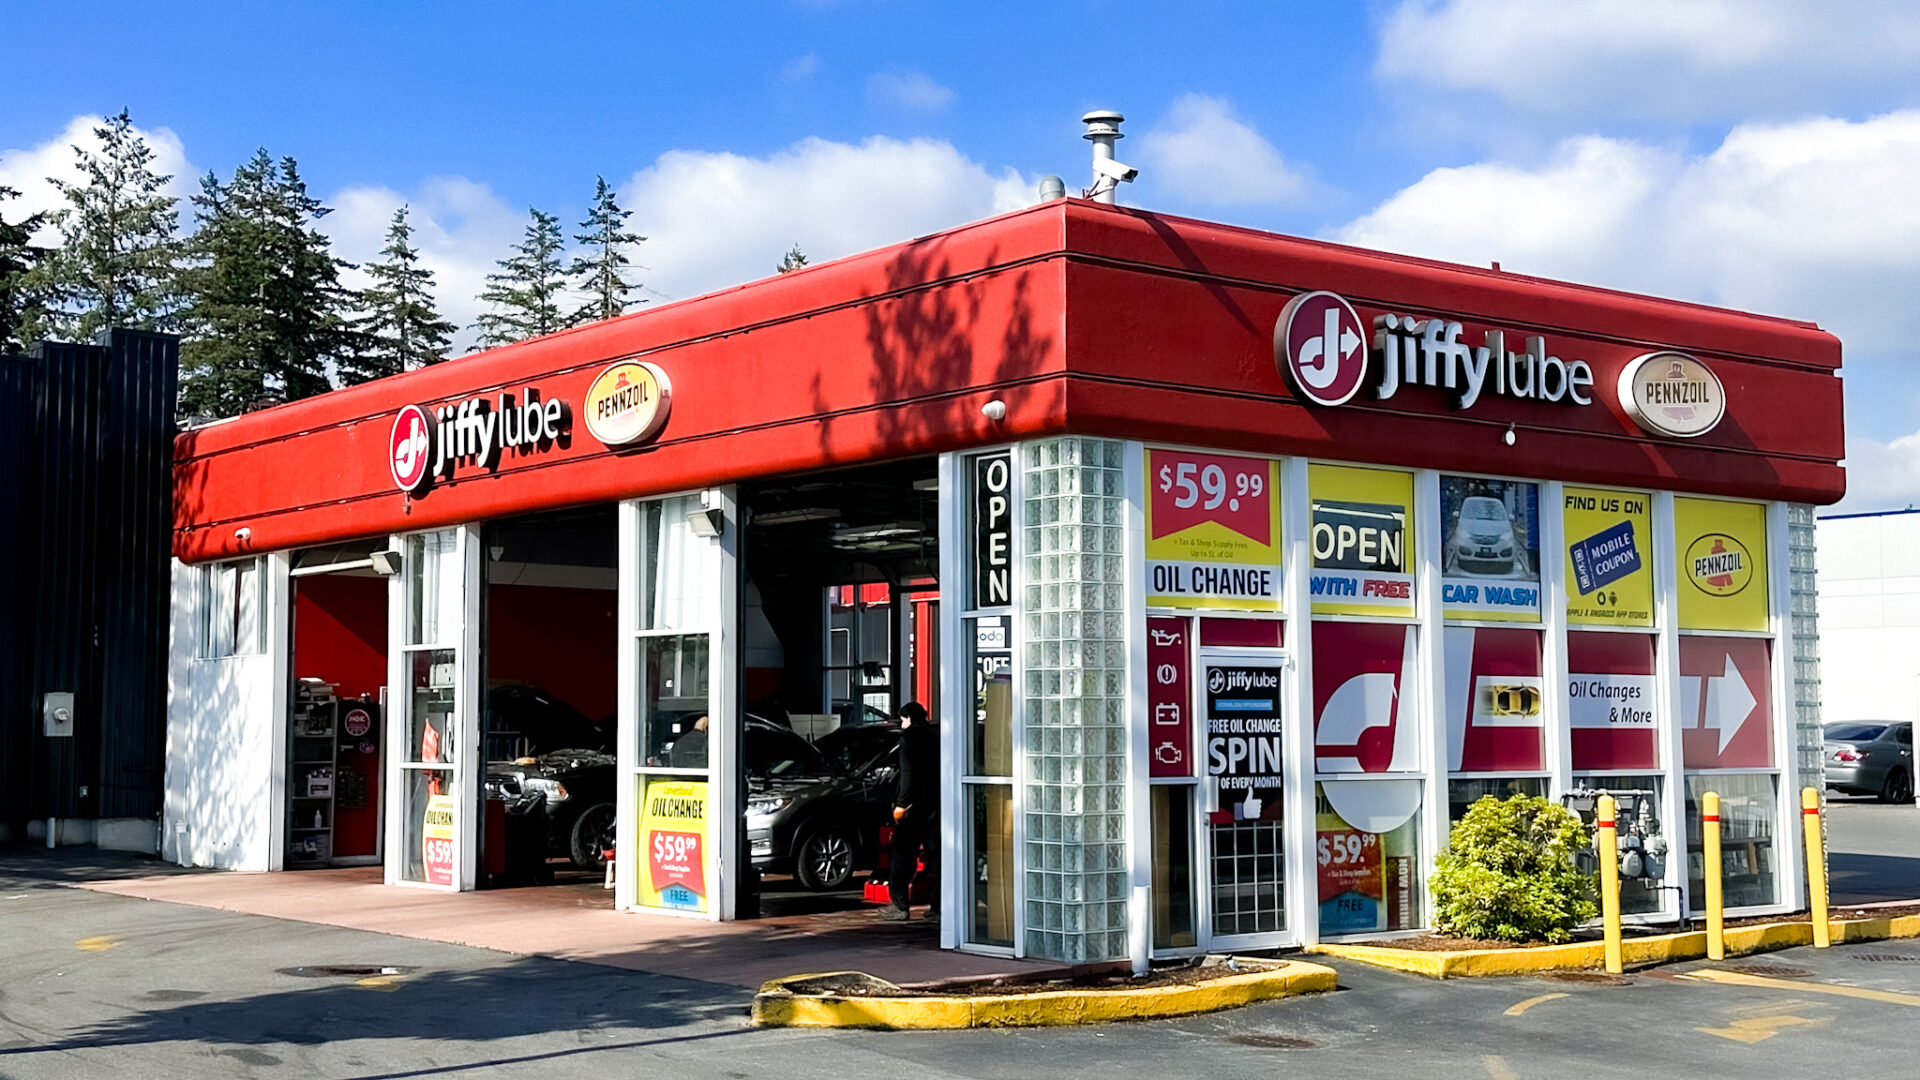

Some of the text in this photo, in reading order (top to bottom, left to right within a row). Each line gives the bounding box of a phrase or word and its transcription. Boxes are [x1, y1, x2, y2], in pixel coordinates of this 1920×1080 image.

[1373, 313, 1594, 410] jiffy lube
[597, 380, 649, 420] PENNZOIL
[1645, 379, 1710, 405] PENNZOIL
[433, 387, 562, 477] jiffy lube
[1159, 462, 1264, 512] $59.99
[1565, 496, 1643, 514] FIND US ON
[986, 459, 1009, 603] OPEN
[1312, 521, 1402, 569] OPEN
[1591, 532, 1631, 560] MOBILE
[1595, 548, 1635, 576] COUPON
[1694, 559, 1743, 578] PENNZOIL
[1153, 565, 1271, 597] OIL CHANGE
[1310, 575, 1411, 599] WITH FREE
[1442, 584, 1537, 607] CAR WASH
[1226, 671, 1277, 691] jiffy lube
[1569, 681, 1641, 702] Oil Changes
[1208, 719, 1281, 733] FREE OIL CHANGE
[1609, 706, 1652, 723] & More
[1209, 737, 1280, 775] SPIN
[1220, 777, 1231, 789] OF
[1231, 777, 1254, 789] EVERY
[1254, 776, 1281, 788] MONTH
[437, 811, 453, 826] CHAN
[652, 797, 703, 819] OIL CHANGE
[1398, 858, 1408, 888] NOW
[670, 889, 688, 902] FREE
[1337, 899, 1364, 912] FREE
